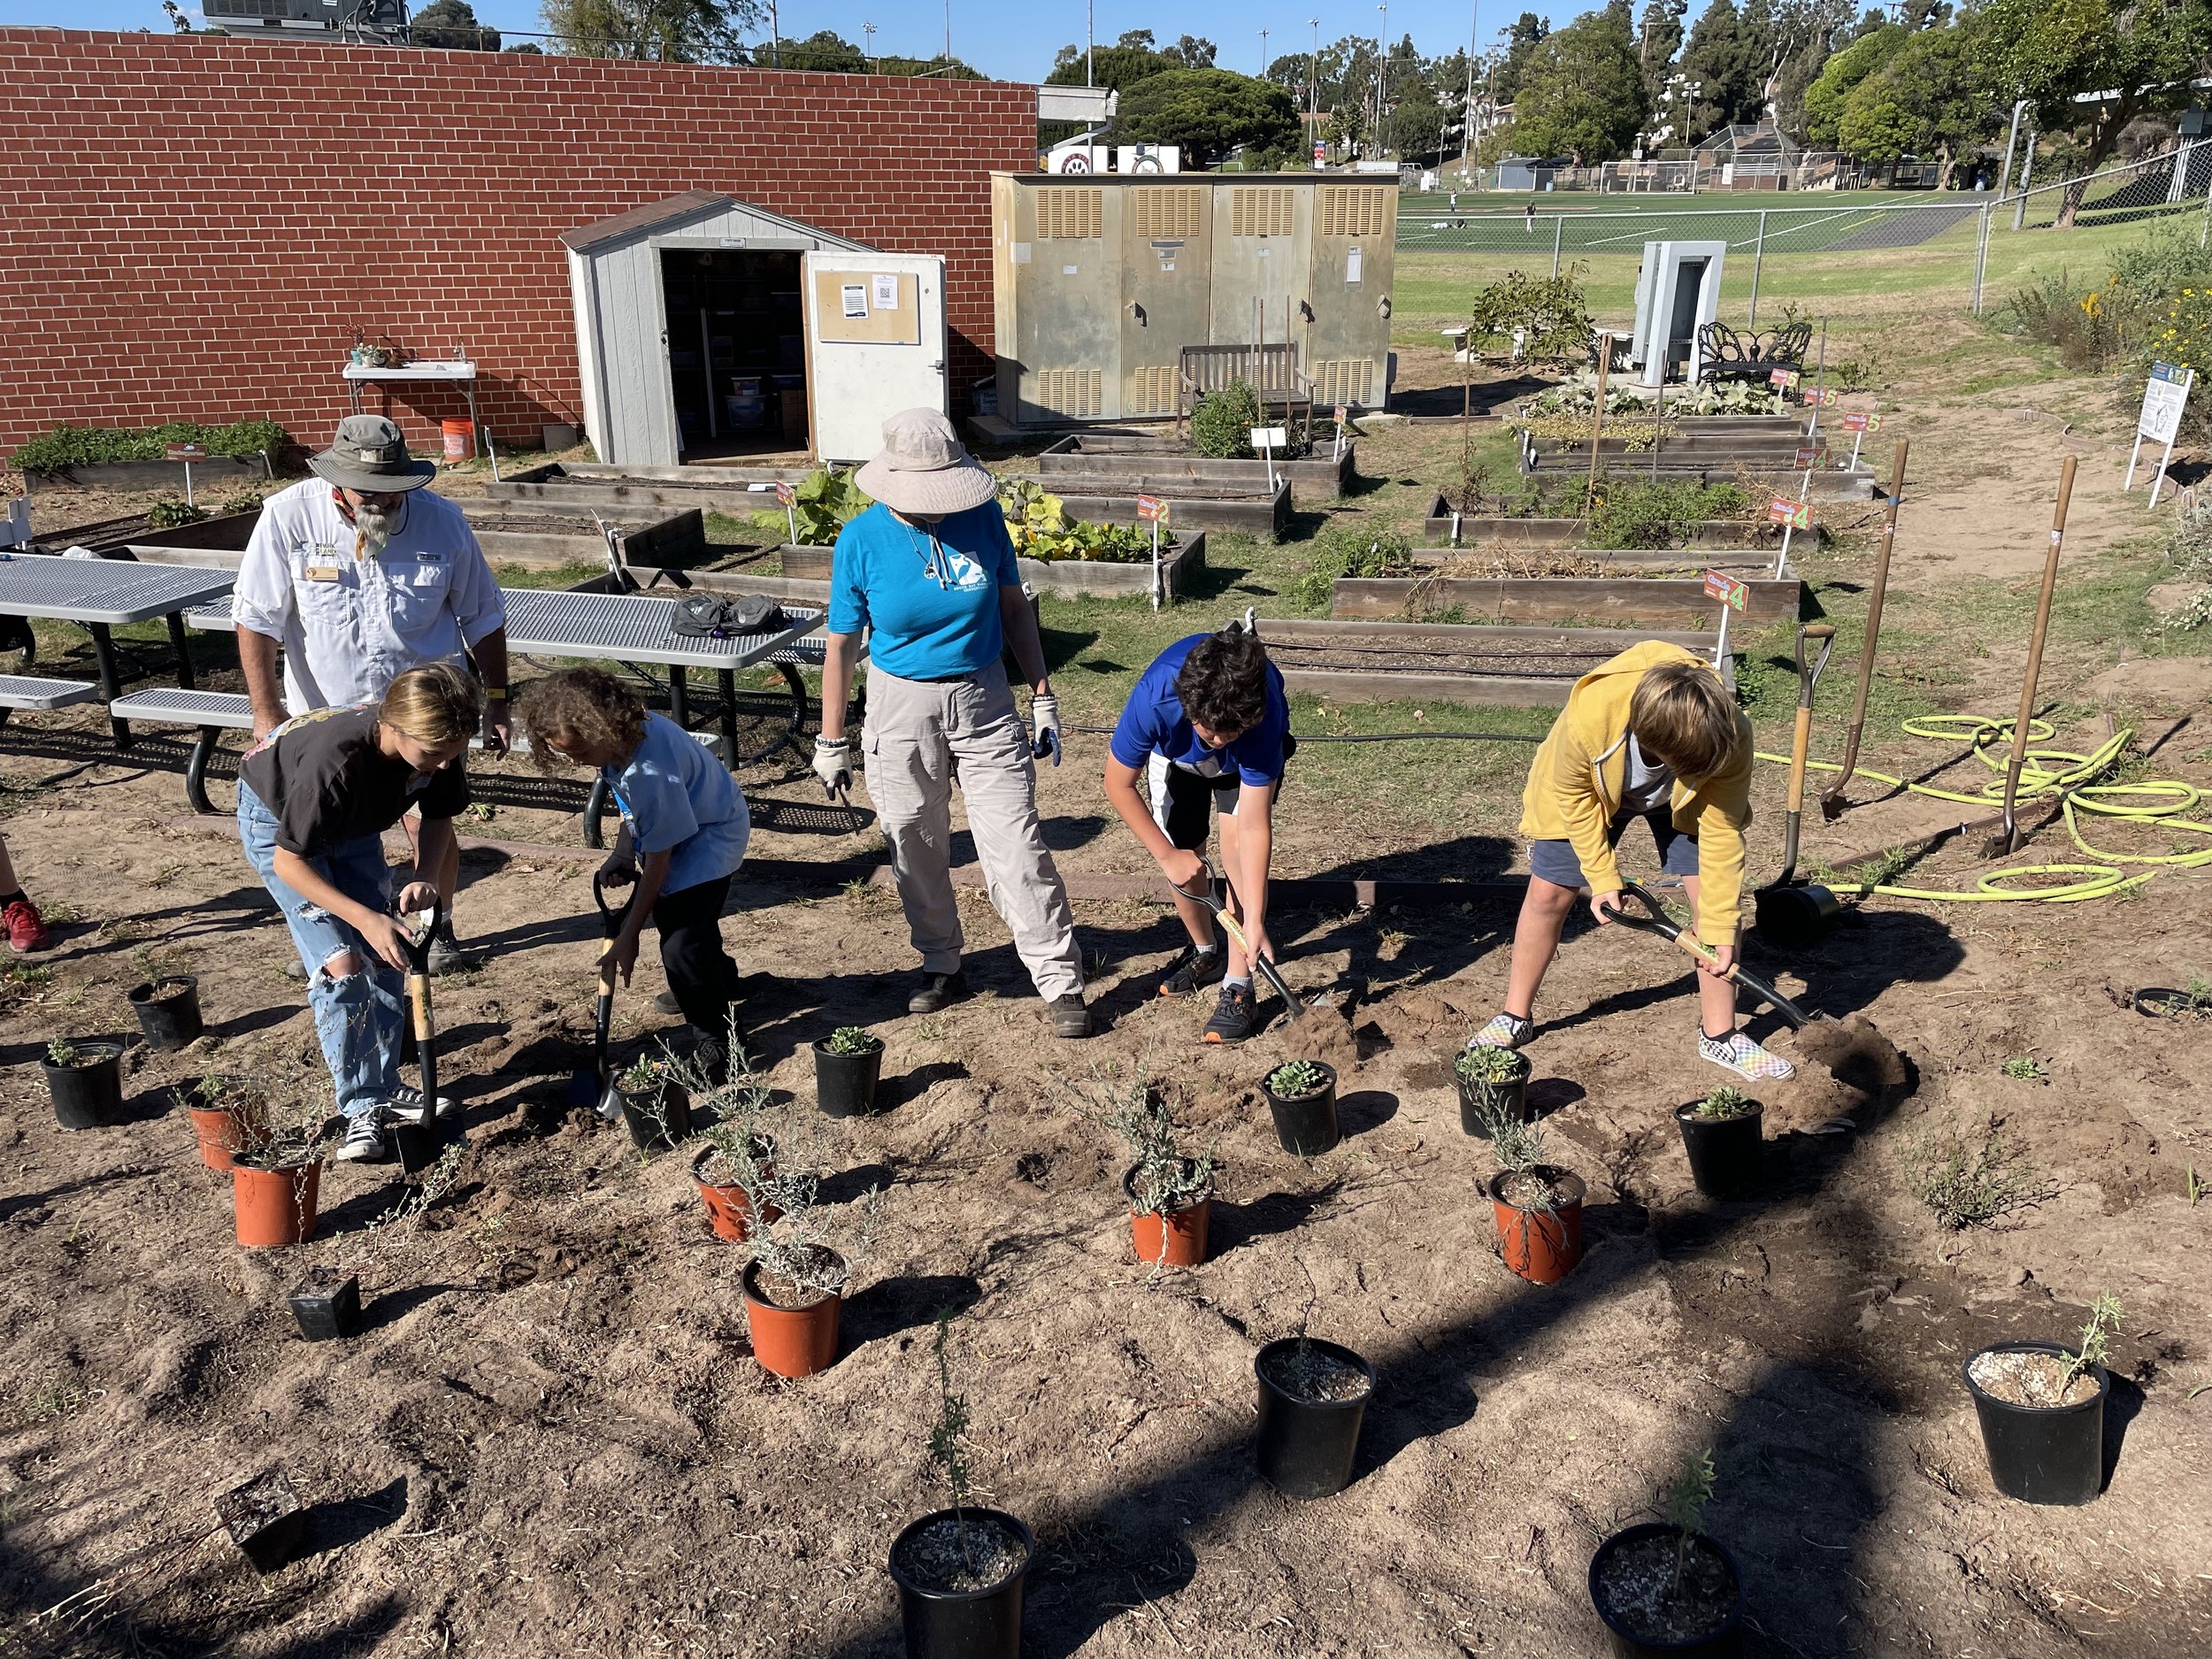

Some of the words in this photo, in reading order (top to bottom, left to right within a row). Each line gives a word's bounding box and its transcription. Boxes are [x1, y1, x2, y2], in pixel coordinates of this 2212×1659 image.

[1786, 372, 1798, 387] 5
[1824, 389, 1838, 406] 5
[1866, 413, 1881, 433] 5
[1814, 448, 1827, 468] 4
[1139, 498, 1158, 510] Grade
[1157, 501, 1169, 524] 2
[1772, 502, 1796, 514] Grade
[1793, 504, 1809, 529] 4
[1708, 573, 1731, 592] Grade
[1729, 584, 1744, 611] 4
